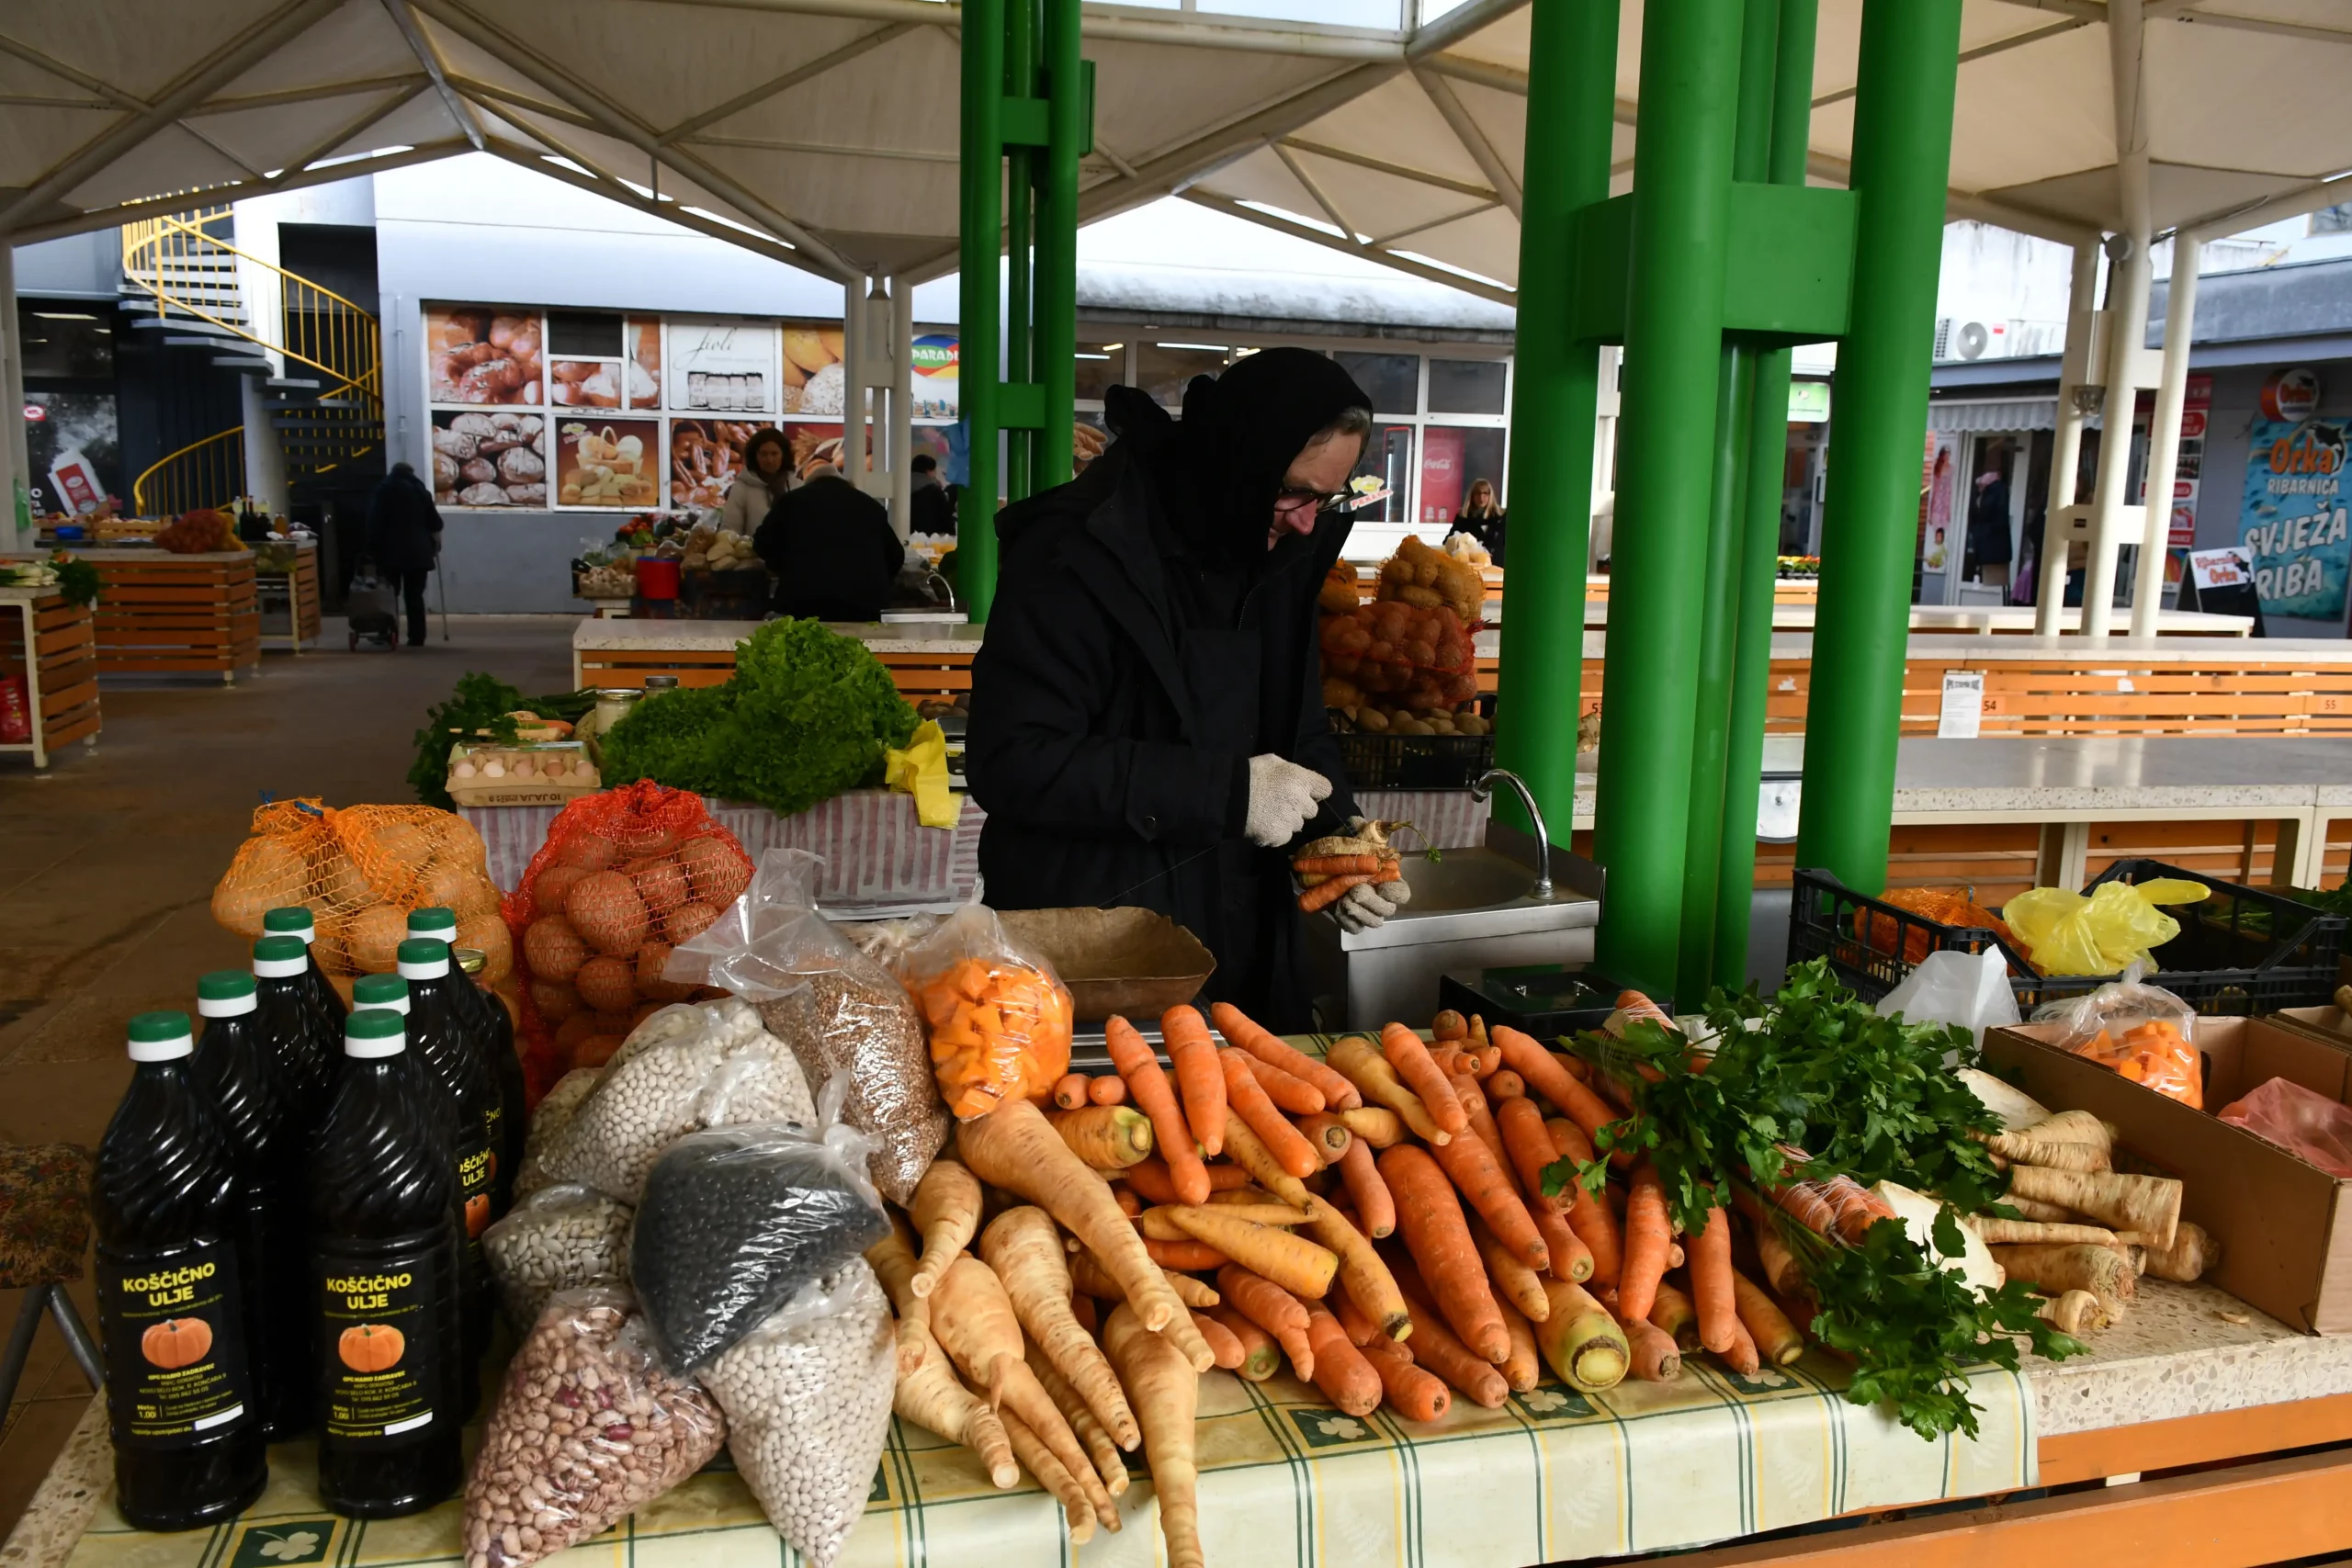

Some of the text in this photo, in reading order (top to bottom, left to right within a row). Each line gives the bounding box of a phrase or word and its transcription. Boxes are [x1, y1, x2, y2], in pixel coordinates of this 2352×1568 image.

[2269, 436, 2335, 475] Orka
[2267, 479, 2339, 494] RIBARNICA
[2245, 501, 2347, 557] SVJEŽA
[2256, 559, 2323, 600] RIBA
[1984, 701, 1996, 711] 54
[2324, 699, 2337, 709] 55
[463, 1167, 485, 1186] ULJE
[122, 1262, 216, 1292] KOŠČIČNO
[326, 1273, 412, 1293] KOŠČIČNO
[149, 1286, 195, 1307] ULJE
[346, 1293, 389, 1309] ULJE
